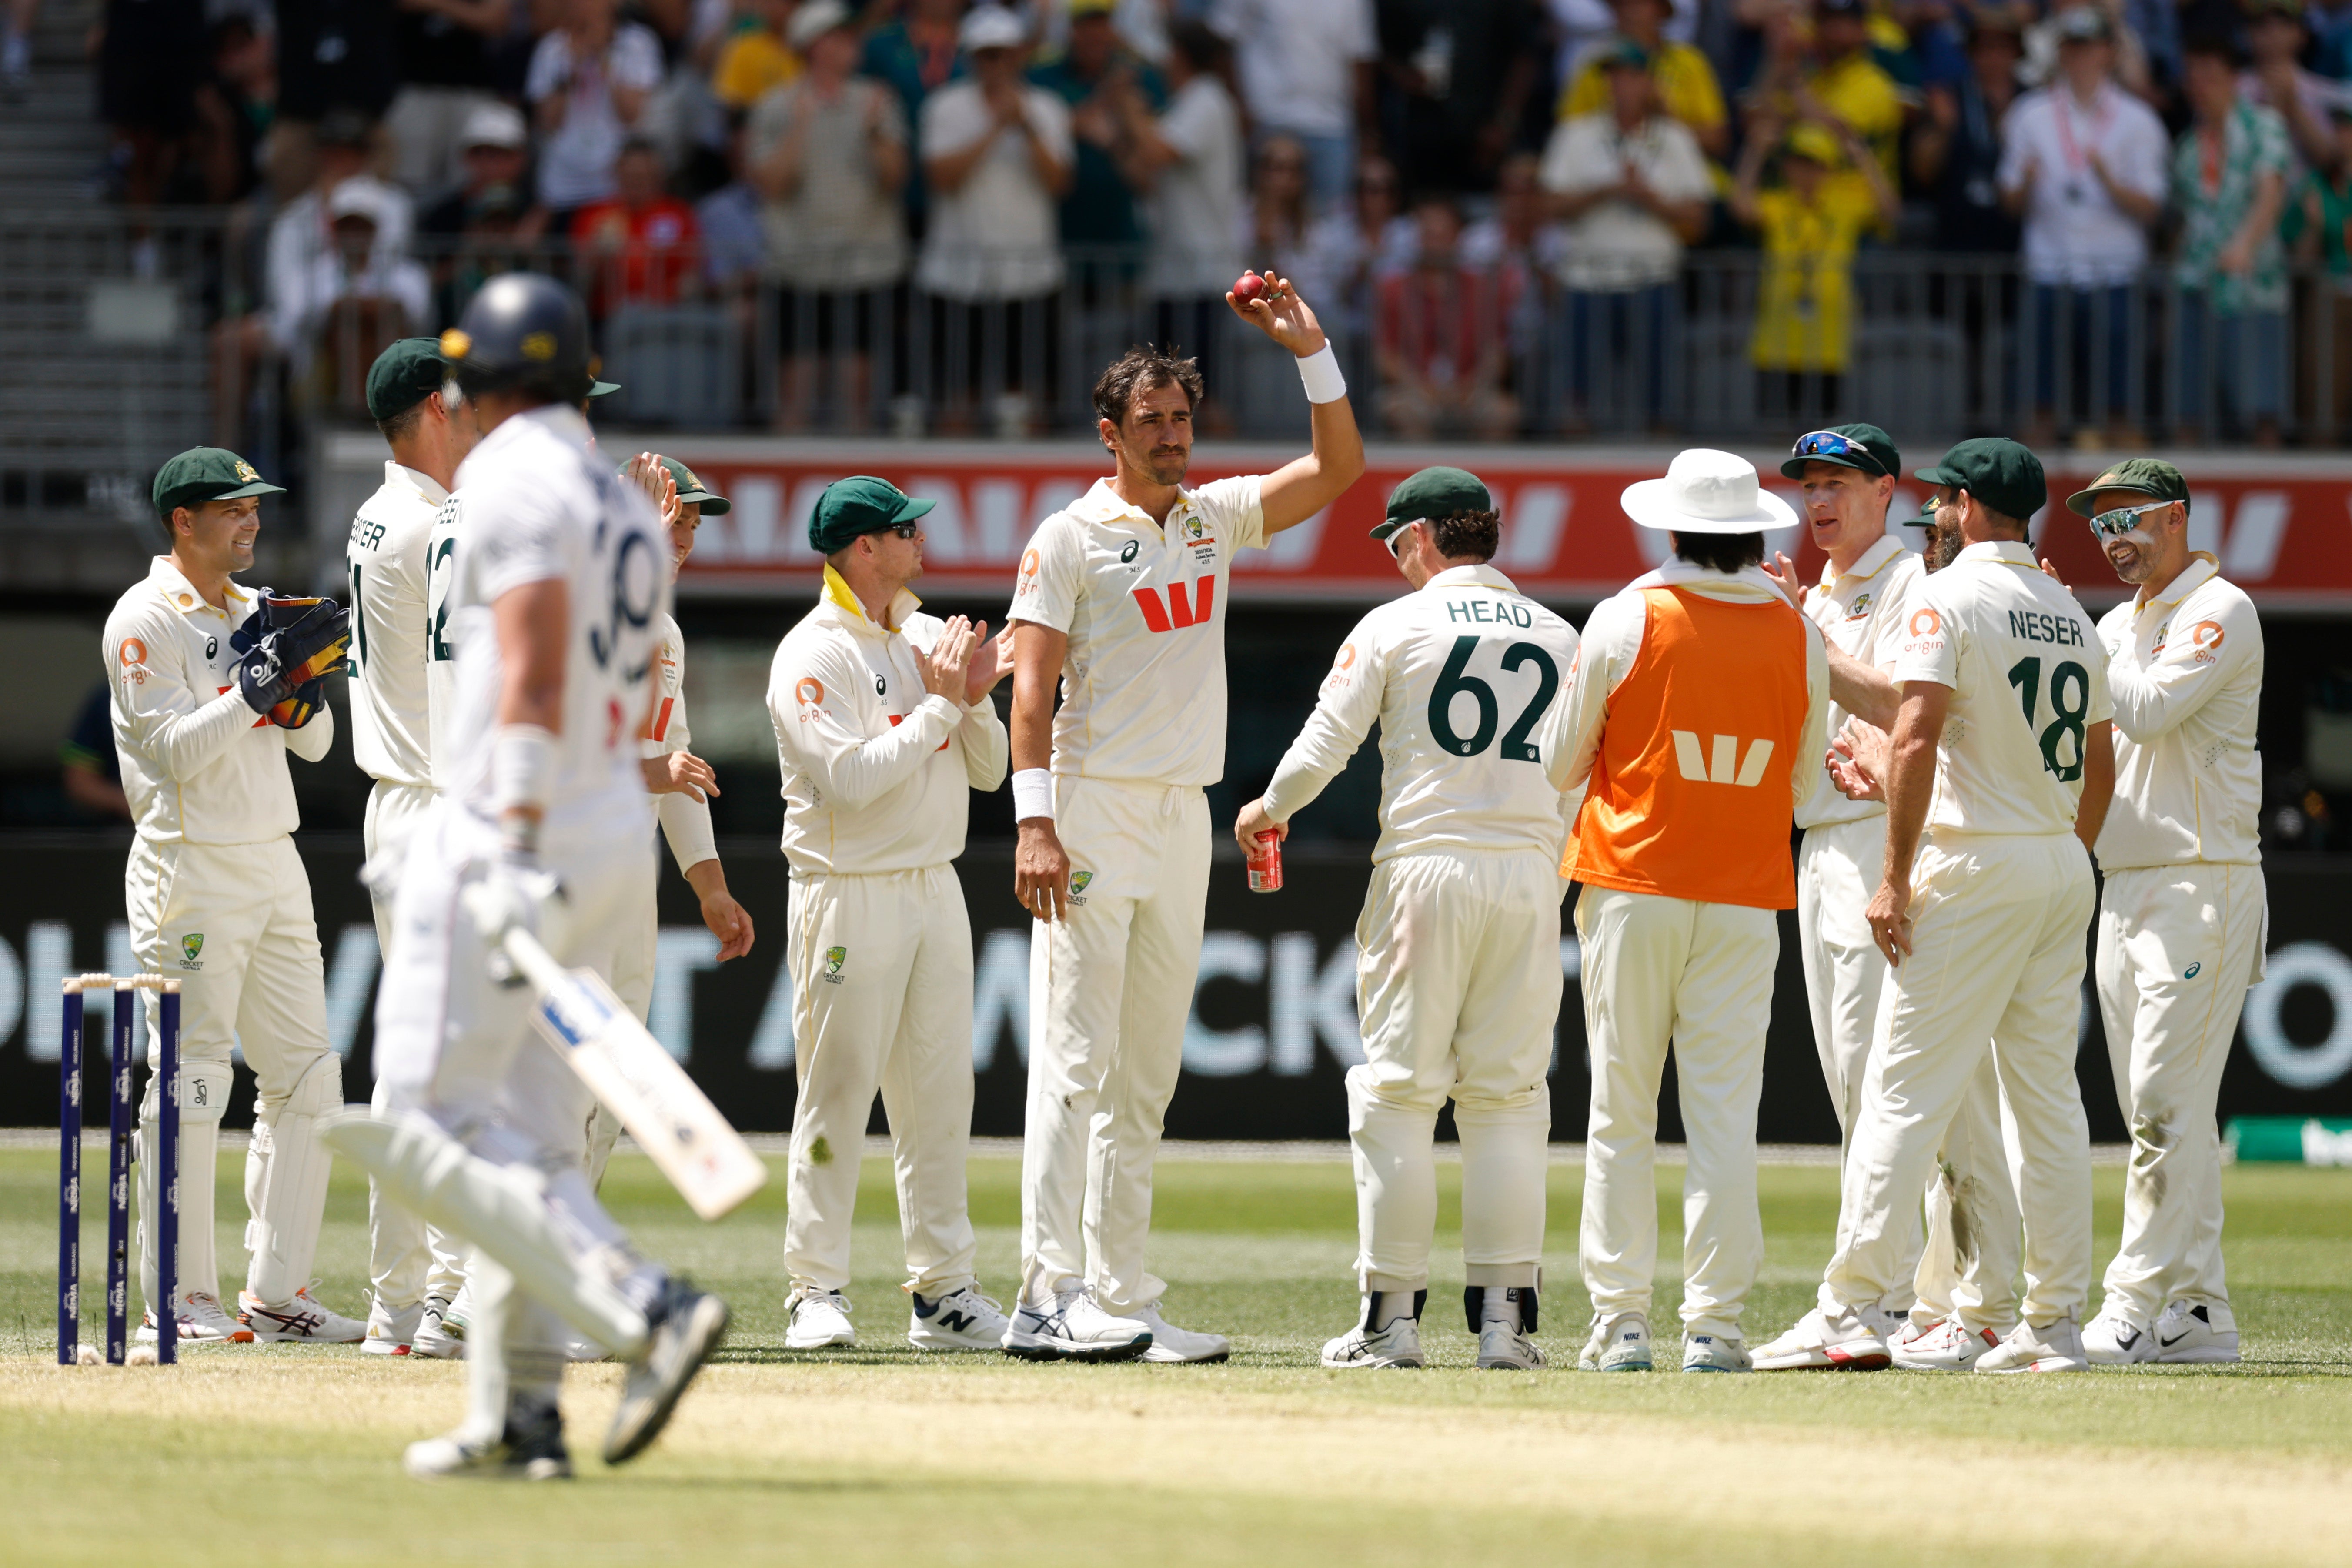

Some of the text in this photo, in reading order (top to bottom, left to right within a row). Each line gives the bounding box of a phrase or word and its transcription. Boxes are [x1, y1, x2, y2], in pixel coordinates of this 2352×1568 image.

[432, 498, 467, 526] REEN
[1446, 600, 1532, 629] HEAD
[2008, 610, 2085, 648] NESER
[1904, 641, 1944, 655] origin
[1428, 635, 1559, 764] 62
[2008, 657, 2089, 782] 18
[823, 972, 845, 982] CRICKET
[1623, 1332, 1640, 1341] NIKE
[1695, 1336, 1714, 1344] NIKE
